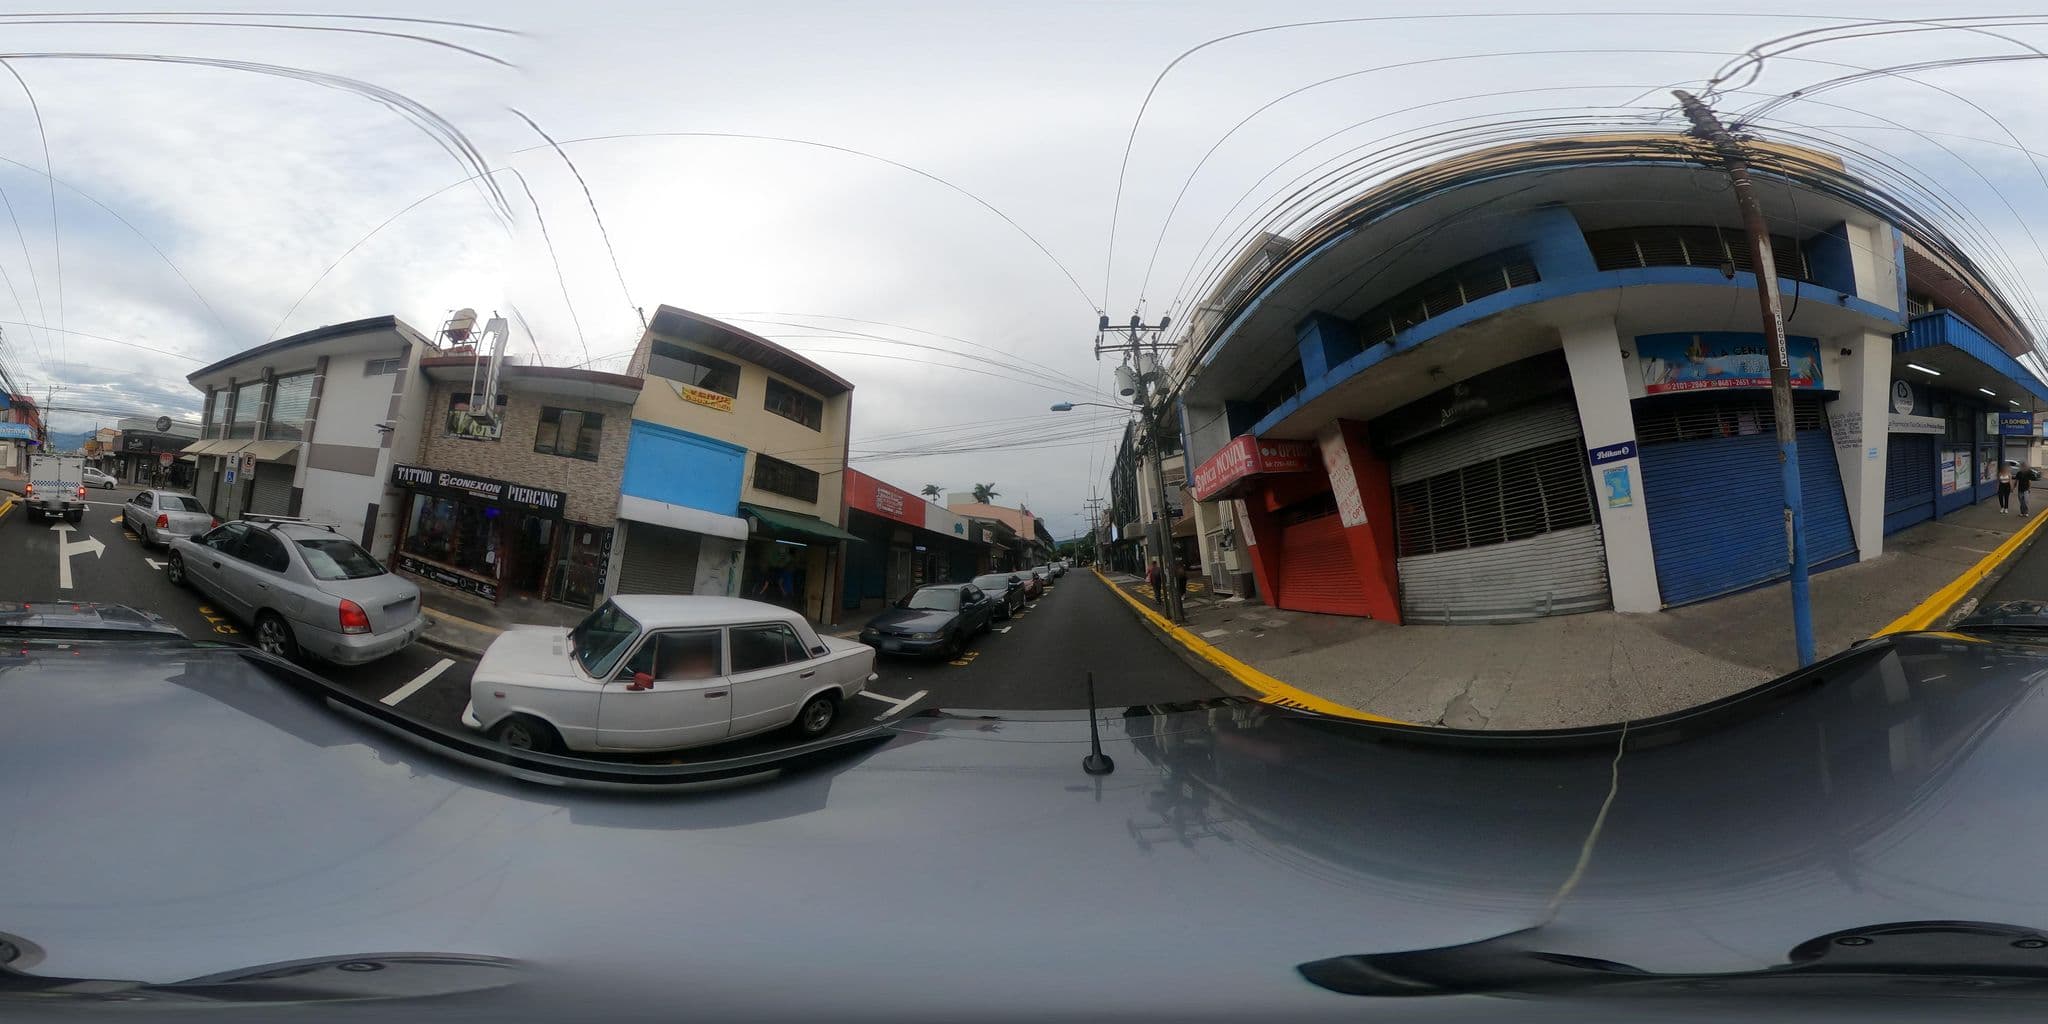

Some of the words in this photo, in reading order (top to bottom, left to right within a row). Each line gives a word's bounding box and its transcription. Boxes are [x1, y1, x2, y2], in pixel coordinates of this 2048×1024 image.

[1596, 449, 1622, 460] Pelikan
[247, 456, 252, 465] E
[397, 466, 433, 485] TATTOO
[449, 477, 502, 494] CONEXION
[507, 484, 558, 509] PIERCING
